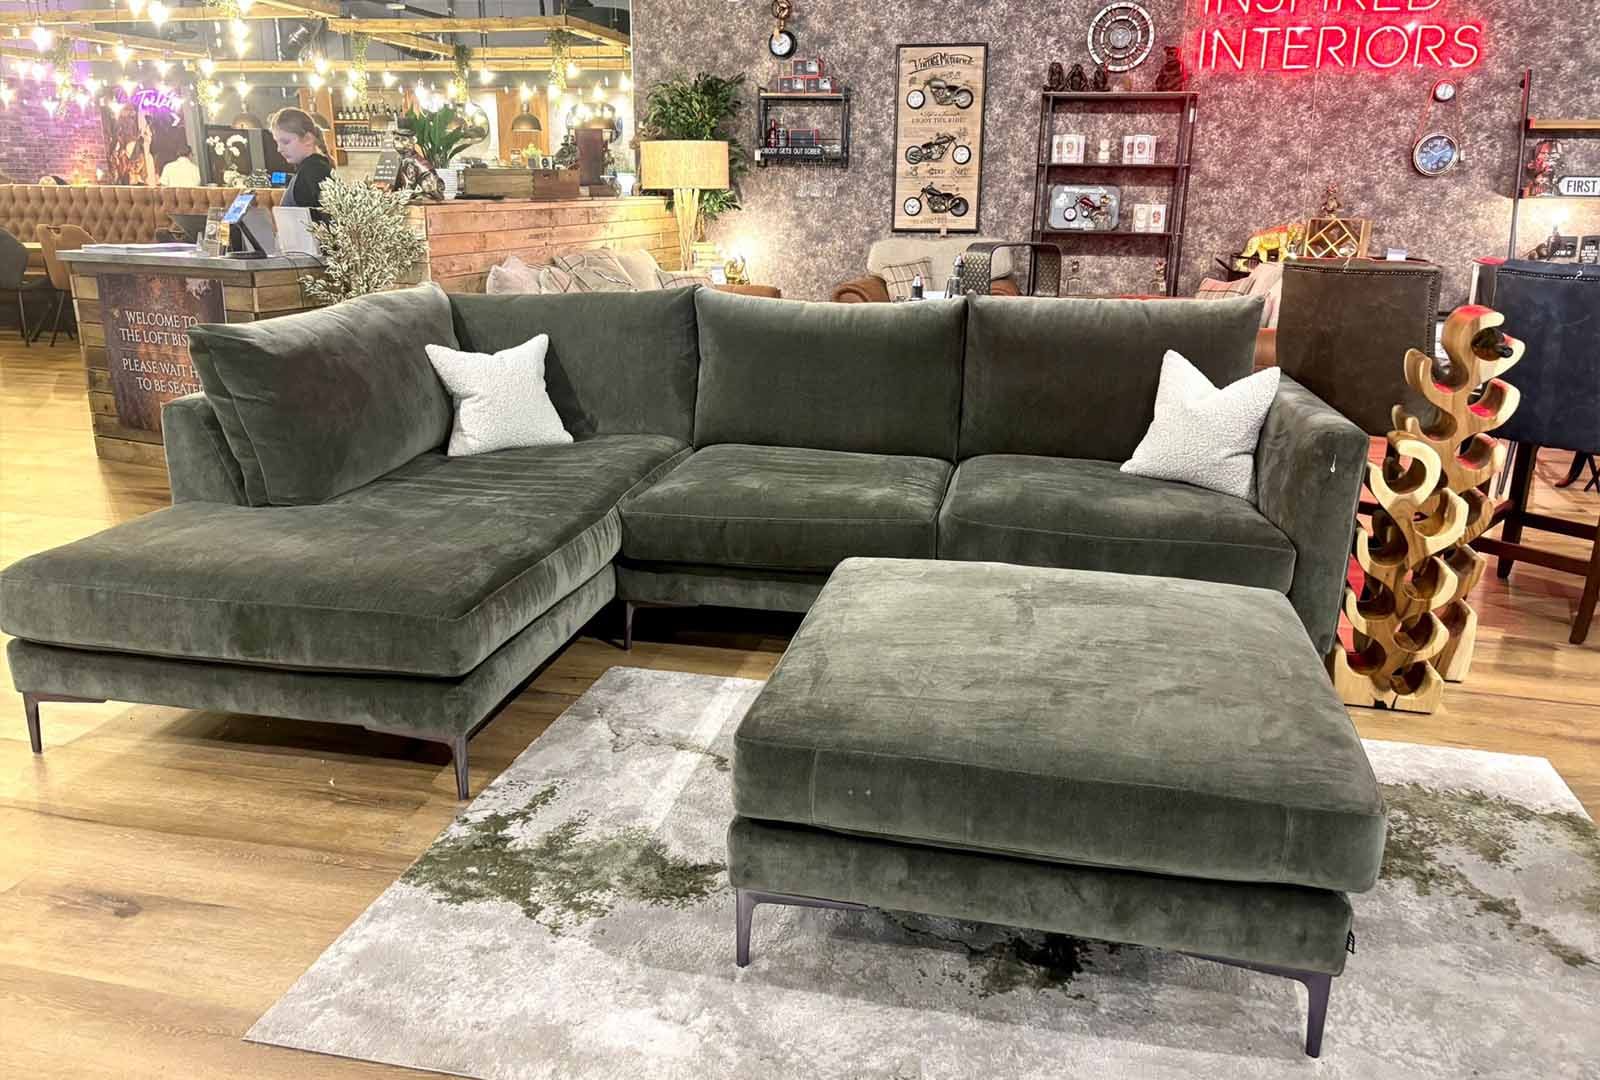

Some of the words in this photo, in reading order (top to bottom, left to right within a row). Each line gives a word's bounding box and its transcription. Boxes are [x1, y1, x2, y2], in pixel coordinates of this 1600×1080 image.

[1199, 25, 1480, 69] INTERIORS
[1566, 180, 1598, 193] FIRST
[125, 310, 180, 328] WELCOME
[181, 315, 199, 328] TO
[119, 328, 141, 342] THE
[143, 331, 170, 345] LOFT
[122, 358, 158, 374] PLEASE
[159, 362, 187, 377] WAIT
[136, 377, 152, 391] TO
[154, 380, 166, 392] BE
